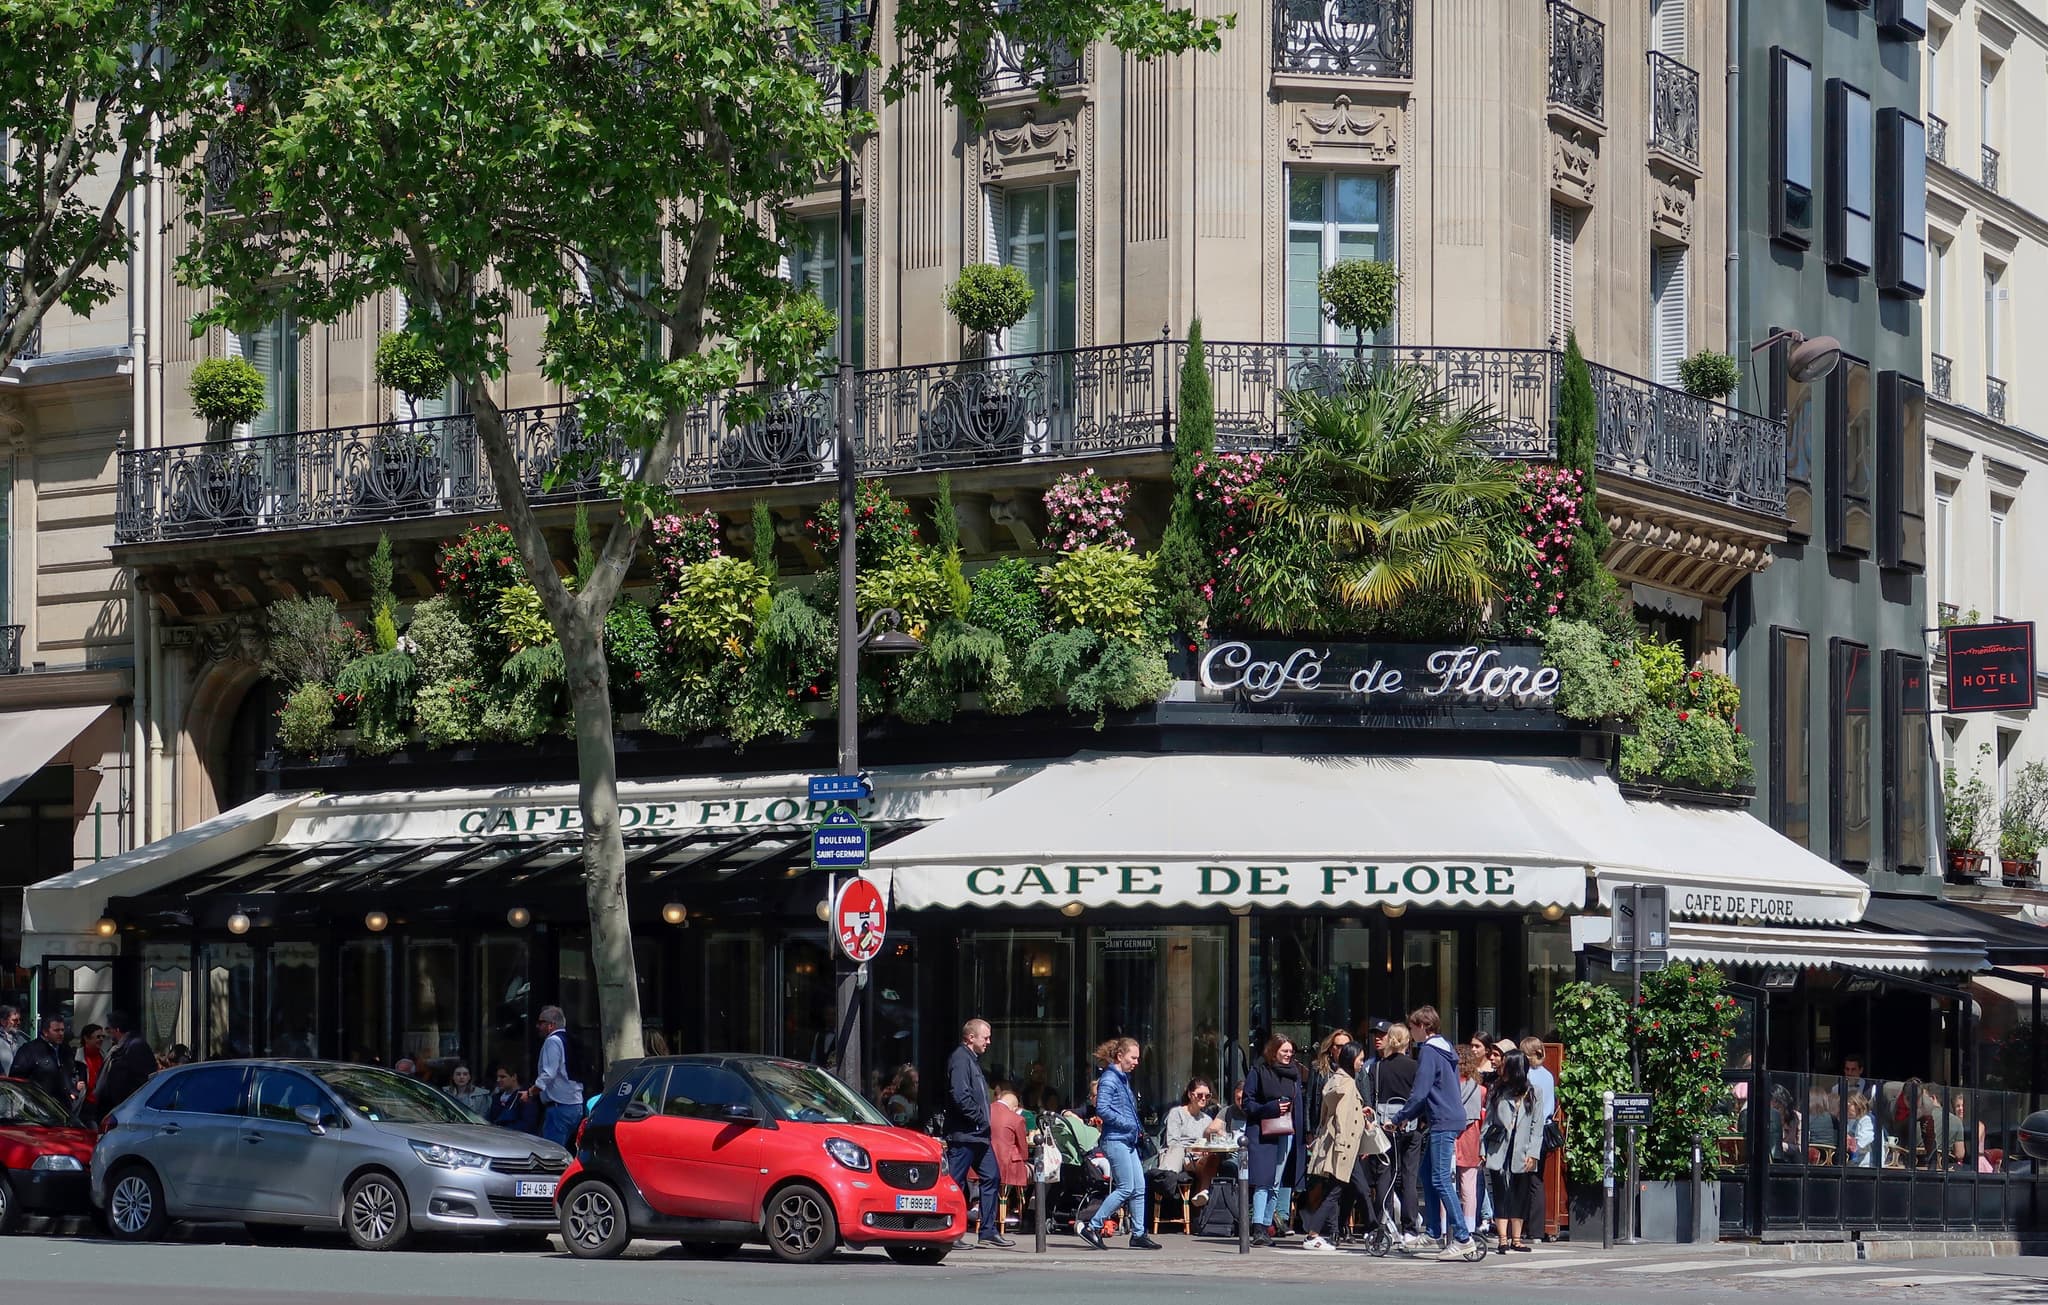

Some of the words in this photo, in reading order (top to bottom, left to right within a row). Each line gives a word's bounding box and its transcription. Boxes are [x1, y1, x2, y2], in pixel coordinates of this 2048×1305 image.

[1200, 640, 1330, 702] Café
[1349, 659, 1403, 694] de
[1423, 645, 1561, 698] Flore
[1962, 673, 2017, 687] HOTEL
[459, 807, 583, 833] CAFE
[618, 803, 677, 828] DE
[697, 798, 875, 825] FLOR
[819, 835, 862, 845] BOULEVARD
[816, 849, 865, 859] SAINT-GERMAIN
[965, 866, 1163, 896] CAFE
[1196, 866, 1290, 896] DE
[1320, 865, 1516, 897] FLORE
[1685, 893, 1722, 912] CAFE
[1727, 896, 1746, 913] DE
[1750, 898, 1794, 916] FLORE
[1105, 939, 1124, 948] SAINT
[1124, 938, 1153, 948] GERMAIN
